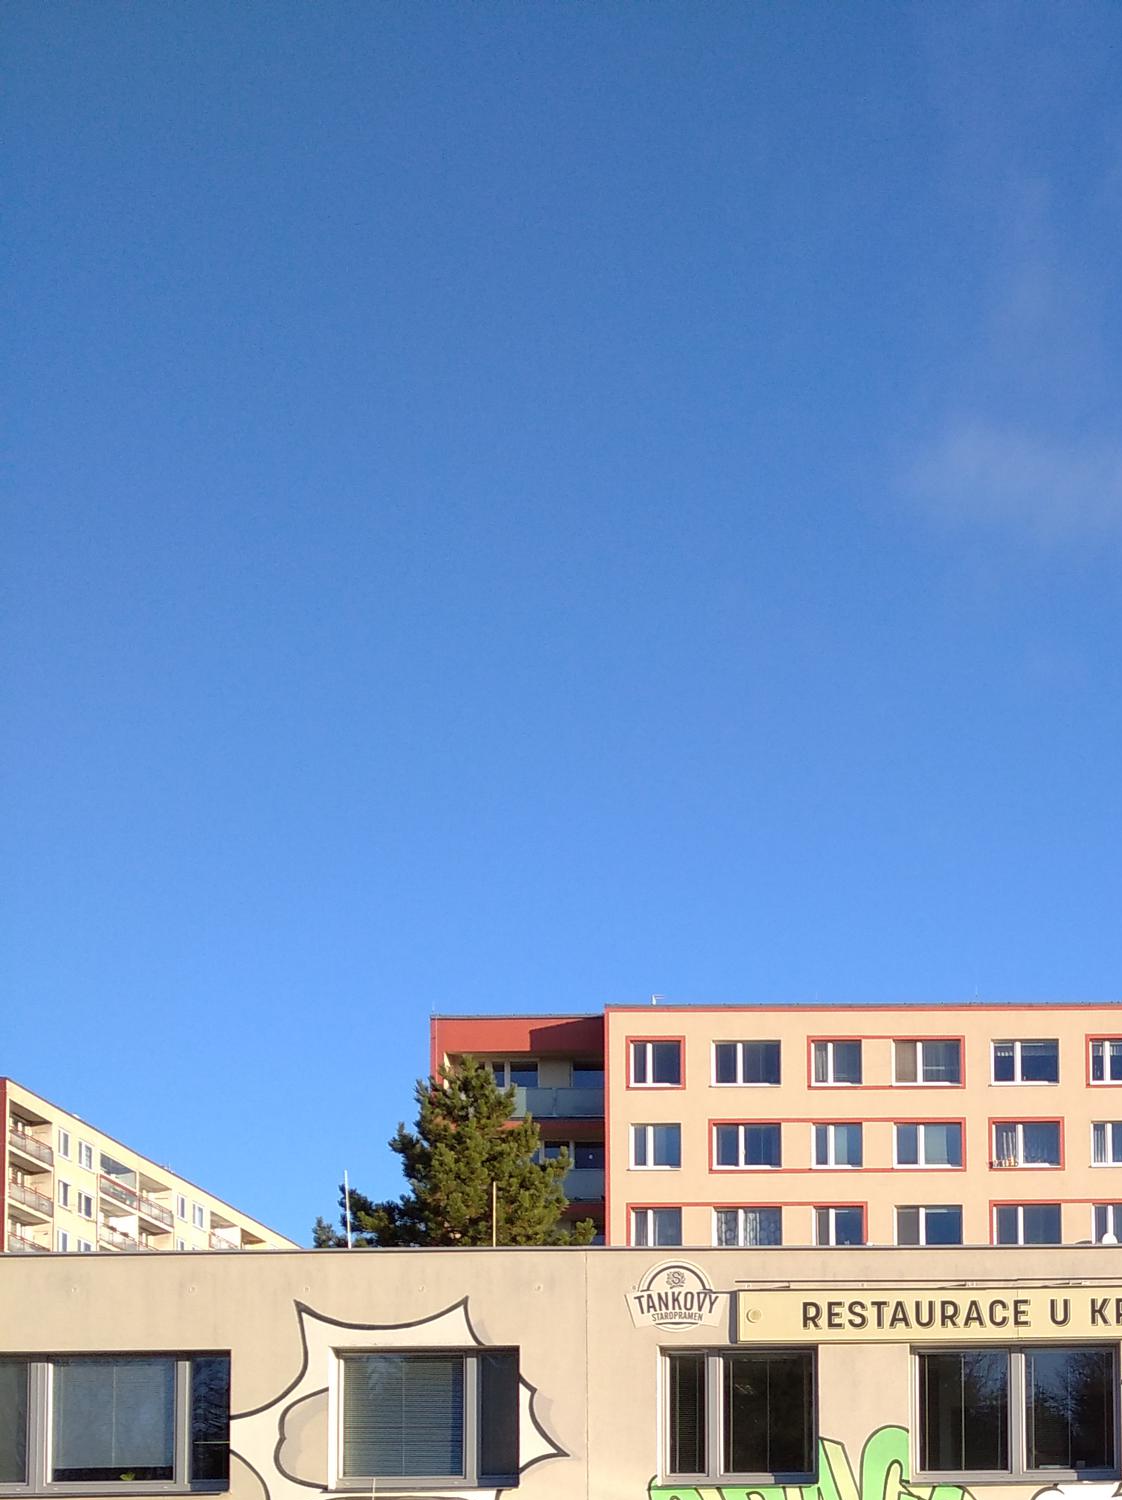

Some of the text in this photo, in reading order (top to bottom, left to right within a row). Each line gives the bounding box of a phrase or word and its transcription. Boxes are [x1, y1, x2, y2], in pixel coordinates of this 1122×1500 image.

[651, 1311, 703, 1322] STAROPRAMEN
[801, 1299, 1031, 1330] RESTAURACE
[1049, 1298, 1071, 1327] U
